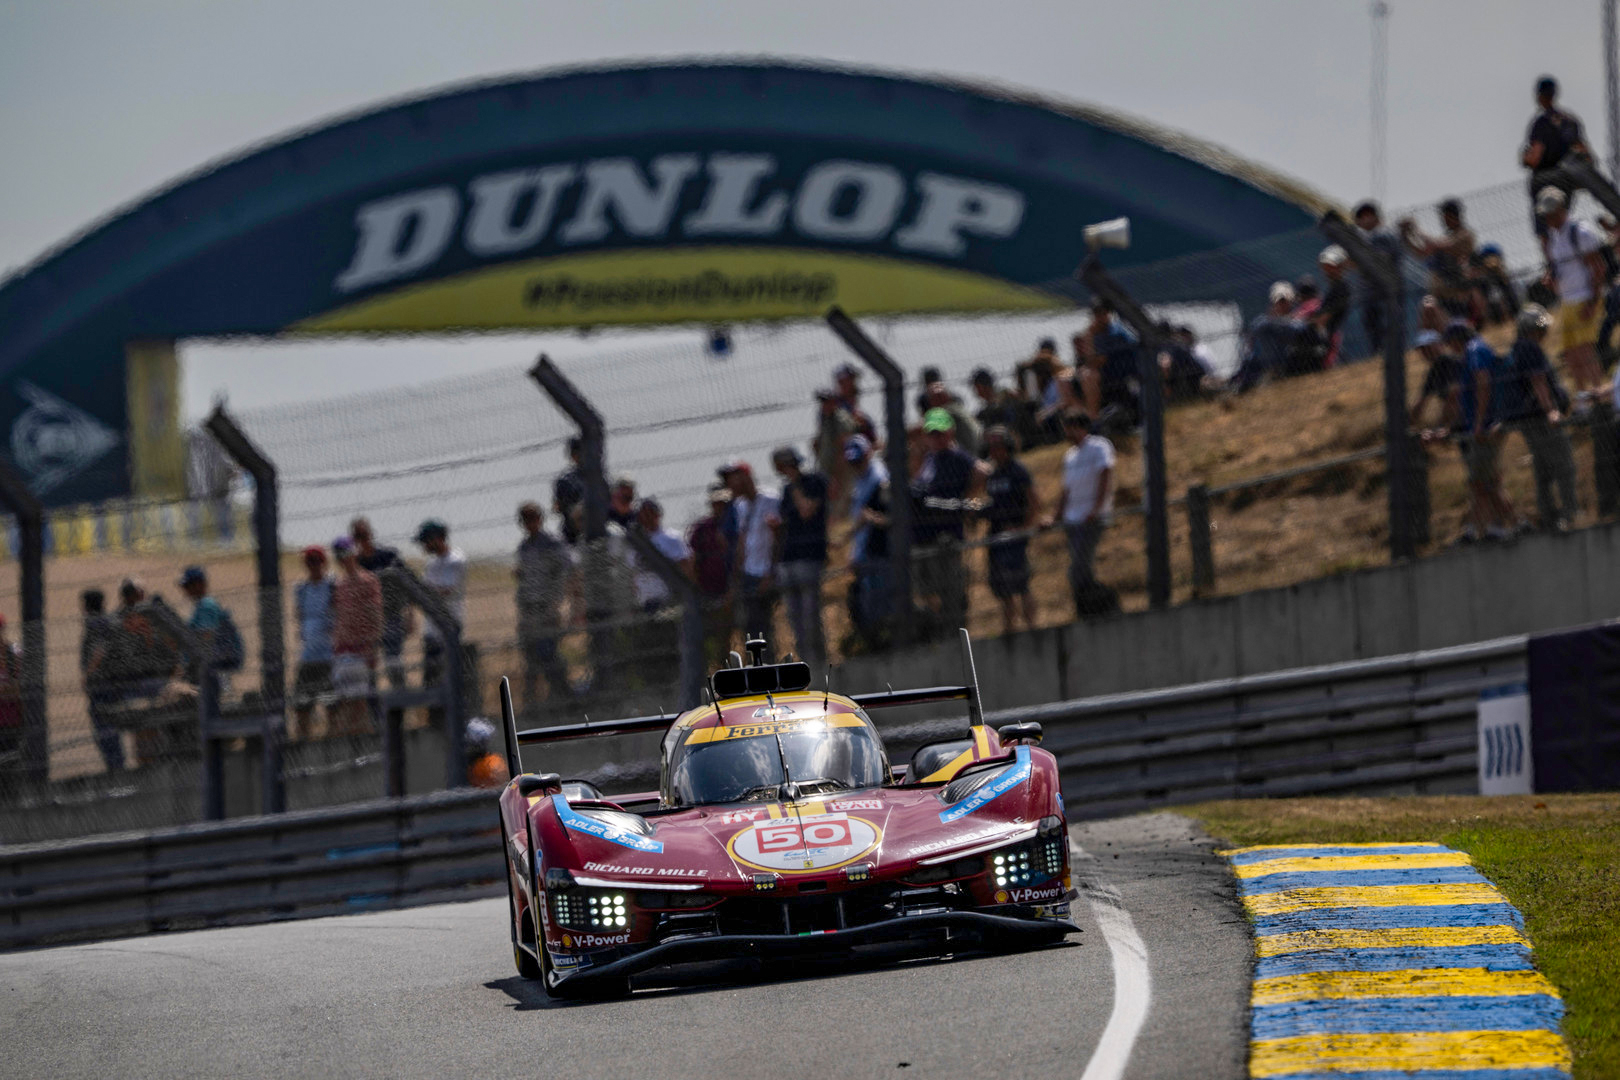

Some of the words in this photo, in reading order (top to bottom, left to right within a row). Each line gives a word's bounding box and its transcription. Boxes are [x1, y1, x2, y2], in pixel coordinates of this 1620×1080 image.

[332, 151, 1026, 293] DUNLOP
[947, 798, 985, 820] ADLER
[565, 818, 605, 835] ADLER
[761, 823, 846, 850] 50
[583, 861, 655, 876] RICHARD
[657, 868, 709, 877] MILLE
[1010, 887, 1060, 902] V-Power
[573, 933, 631, 948] V-Power
